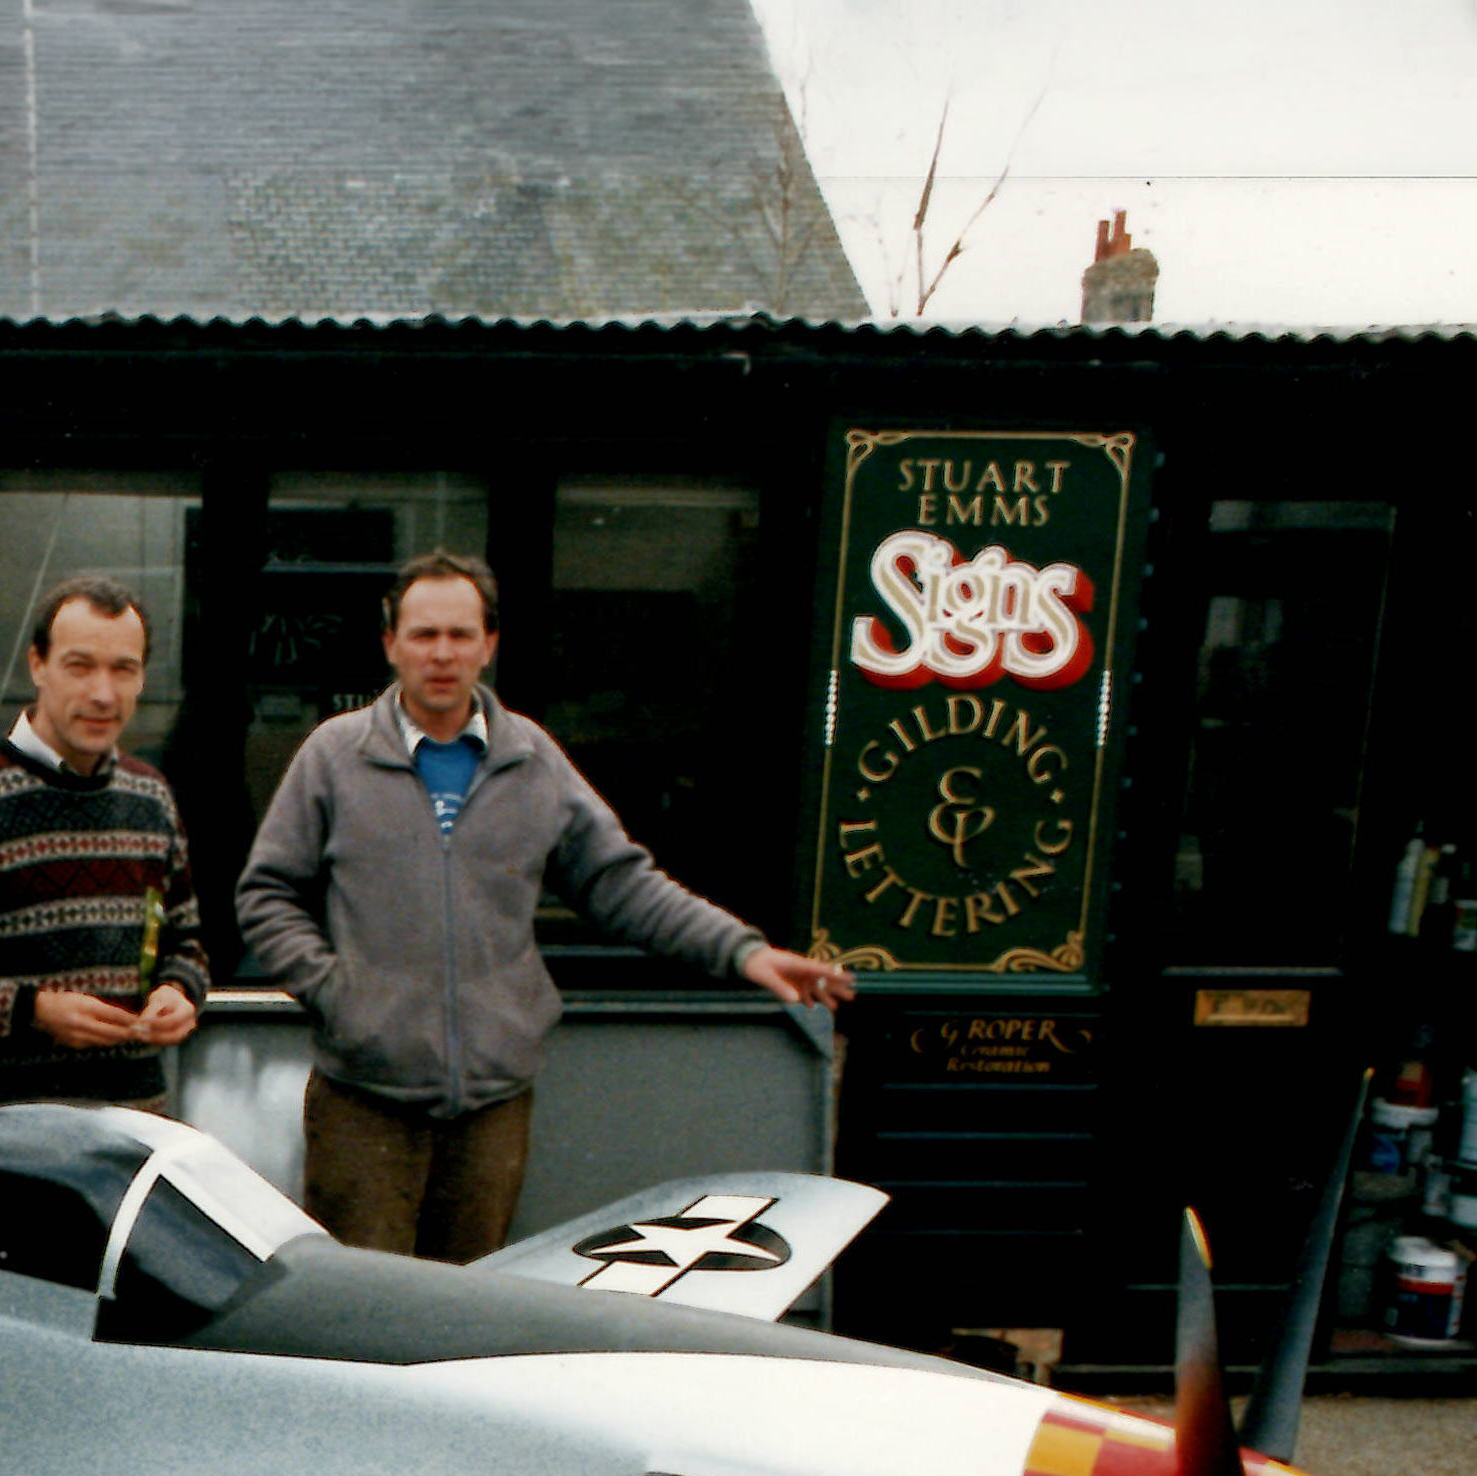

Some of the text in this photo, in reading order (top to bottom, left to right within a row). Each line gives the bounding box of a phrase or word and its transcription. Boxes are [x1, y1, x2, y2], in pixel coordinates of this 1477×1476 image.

[898, 458, 1072, 494] STUART
[918, 495, 1051, 527] EMMS
[850, 528, 1086, 684] Signs
[857, 693, 1068, 785] GILDING
[927, 765, 996, 869] &
[838, 819, 1074, 938] LETTERING
[968, 1018, 1077, 1054] ROPER
